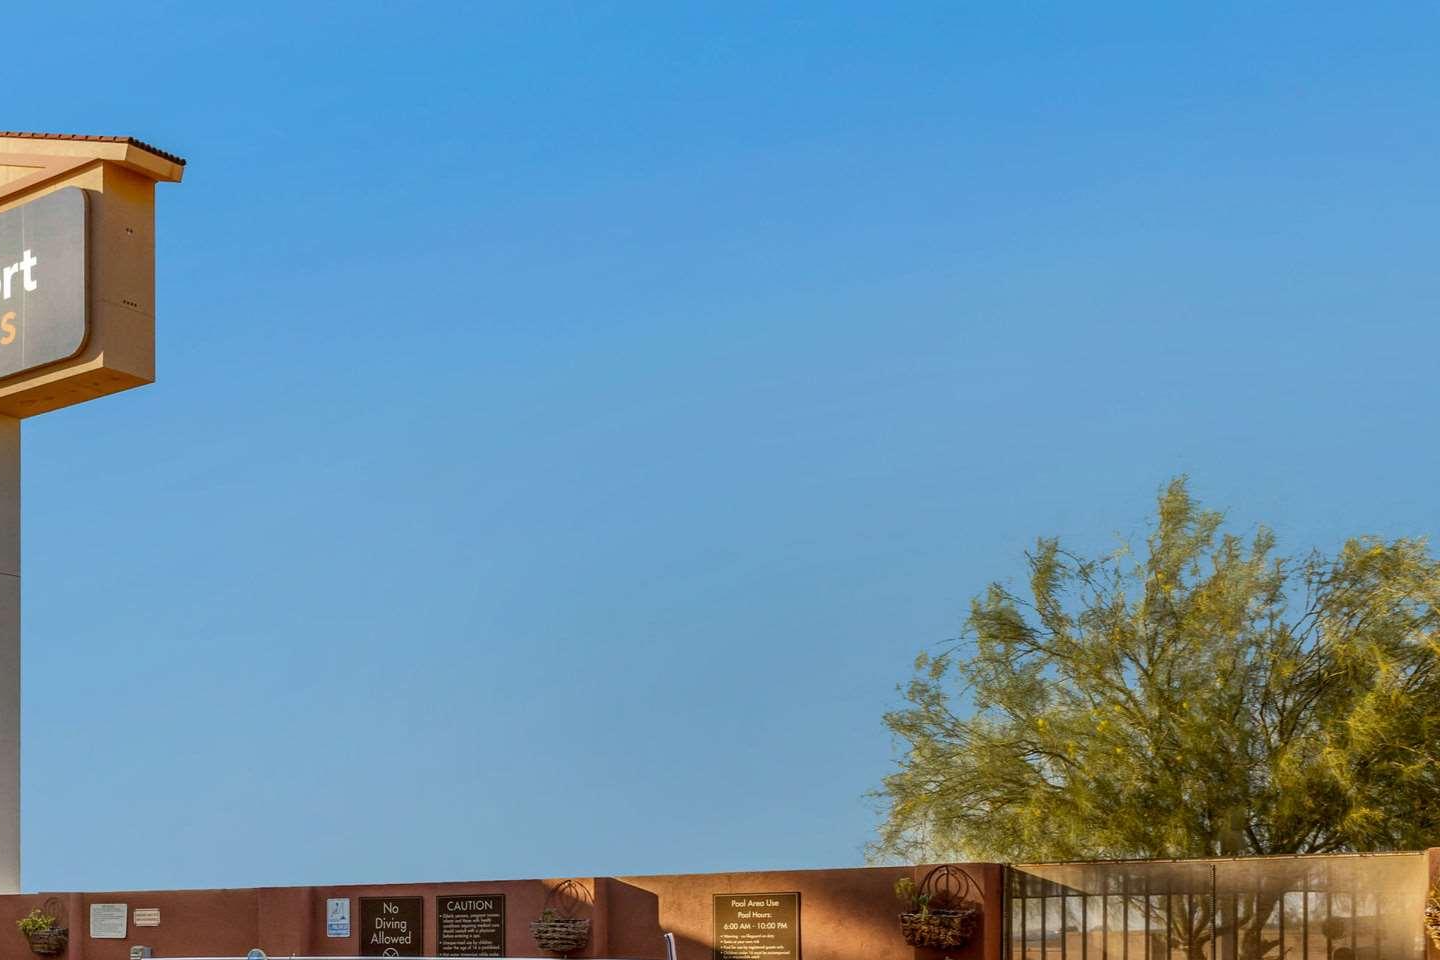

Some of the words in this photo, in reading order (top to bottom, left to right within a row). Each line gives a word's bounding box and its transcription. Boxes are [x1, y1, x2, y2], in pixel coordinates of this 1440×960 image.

[383, 902, 399, 914] No
[446, 900, 493, 911] CAUTION
[731, 899, 746, 907] Pool
[747, 899, 765, 907] Area
[737, 911, 751, 919] Pool
[375, 917, 407, 933] Diving
[723, 922, 739, 930] 6:00
[739, 922, 751, 930] AM
[370, 931, 412, 945] Allowed
